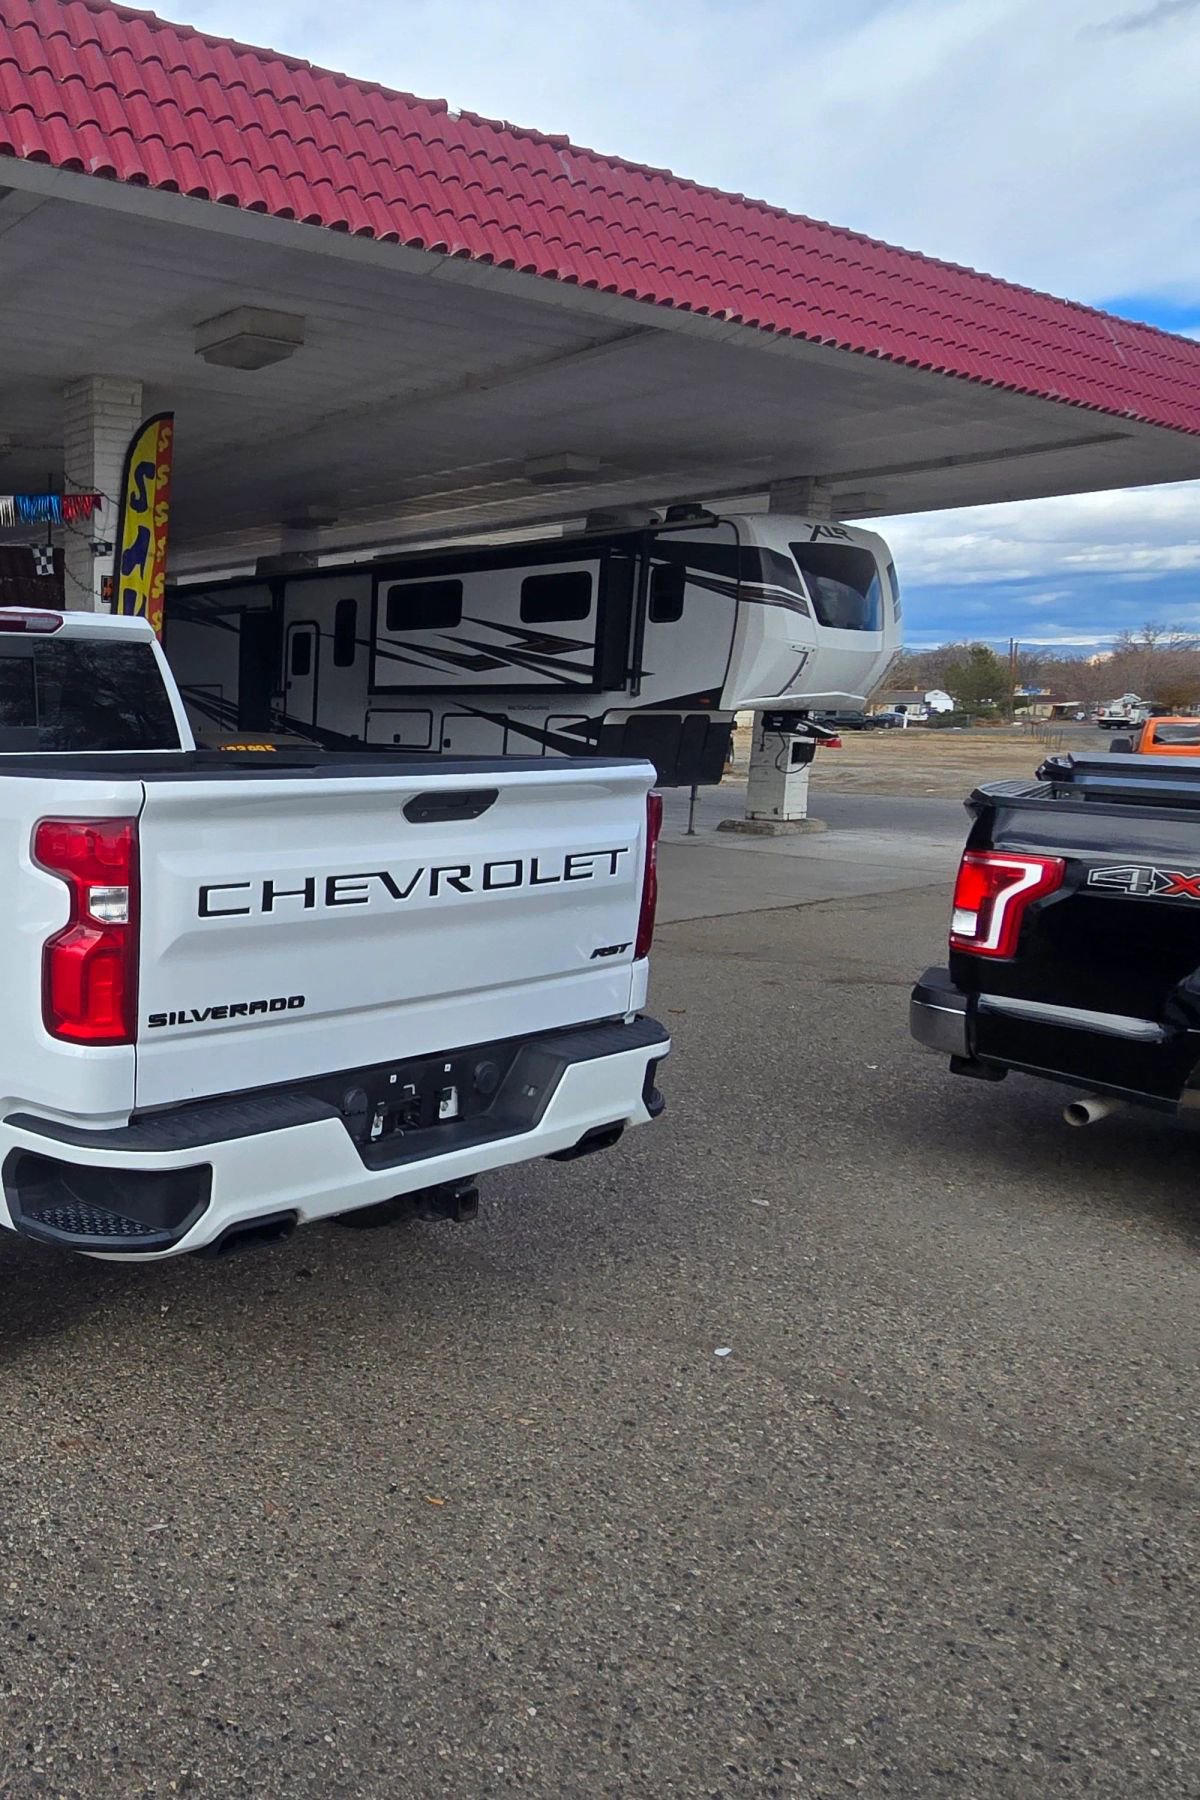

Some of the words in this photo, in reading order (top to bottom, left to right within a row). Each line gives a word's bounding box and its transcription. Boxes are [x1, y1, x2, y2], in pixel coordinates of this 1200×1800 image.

[198, 847, 629, 918] CHEVROLET
[590, 941, 633, 959] RST
[148, 995, 305, 1028] SILVERADO
